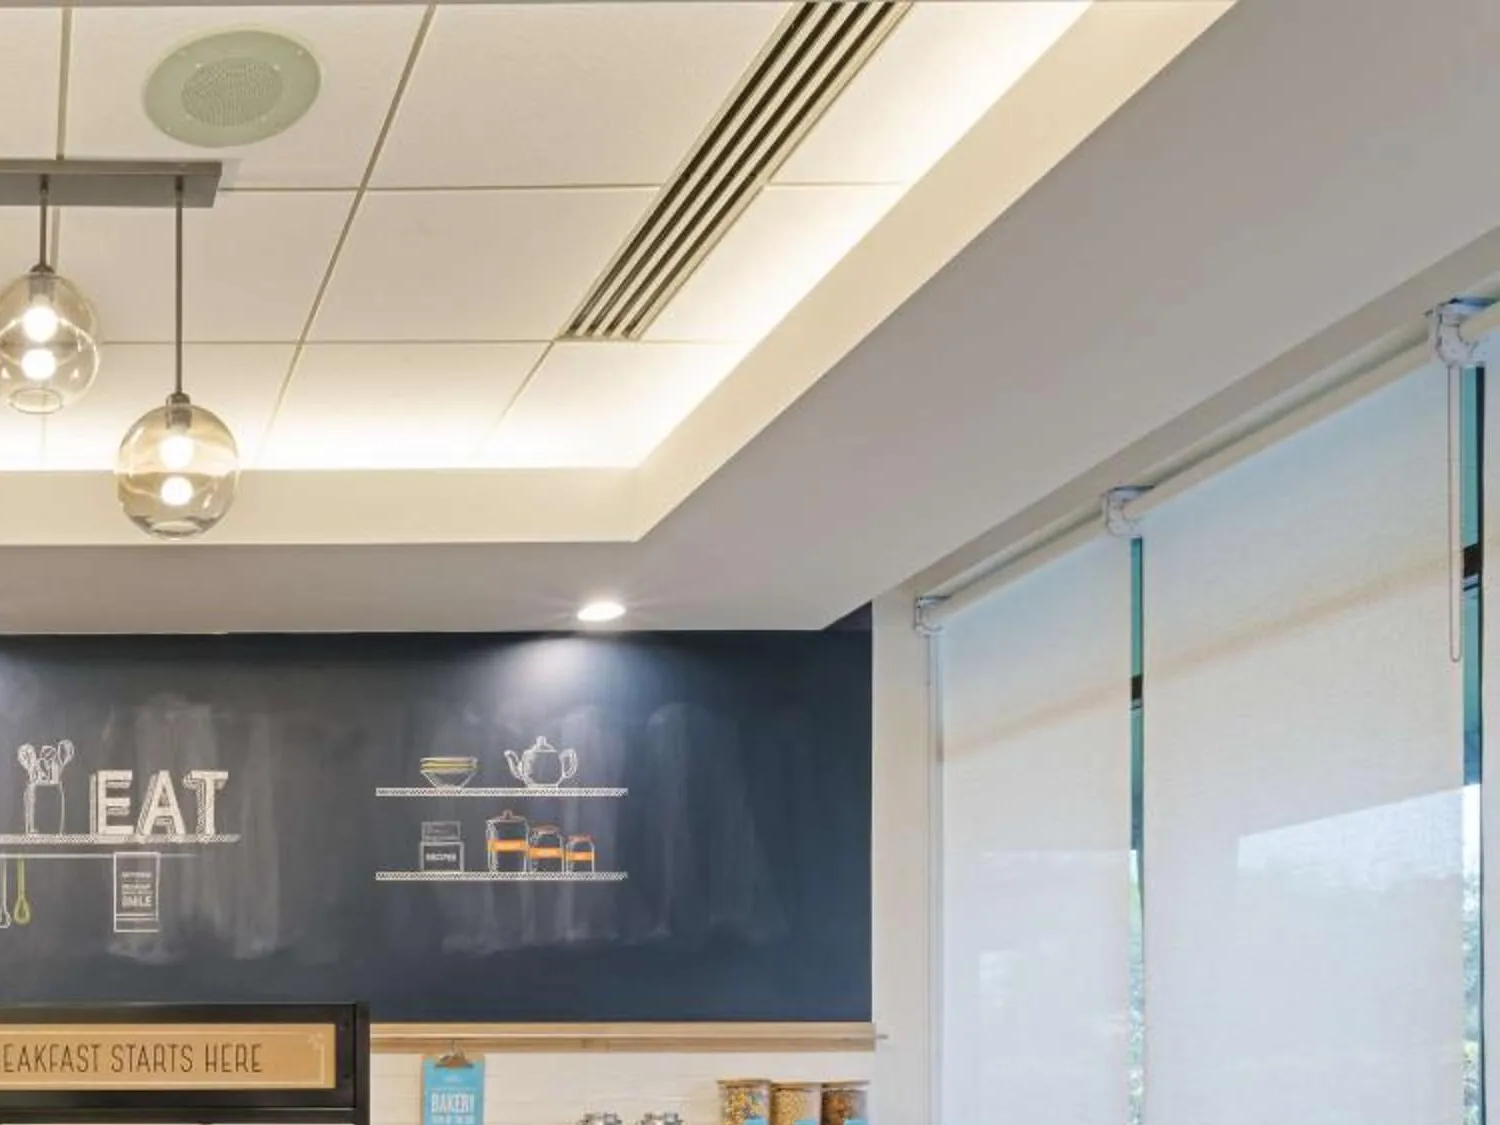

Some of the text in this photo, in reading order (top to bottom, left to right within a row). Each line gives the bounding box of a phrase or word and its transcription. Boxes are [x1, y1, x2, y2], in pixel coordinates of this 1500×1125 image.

[89, 769, 229, 843] EAT
[111, 1042, 193, 1073] STARTS
[205, 1043, 264, 1073] HERE
[431, 1093, 475, 1113] BAKERY
